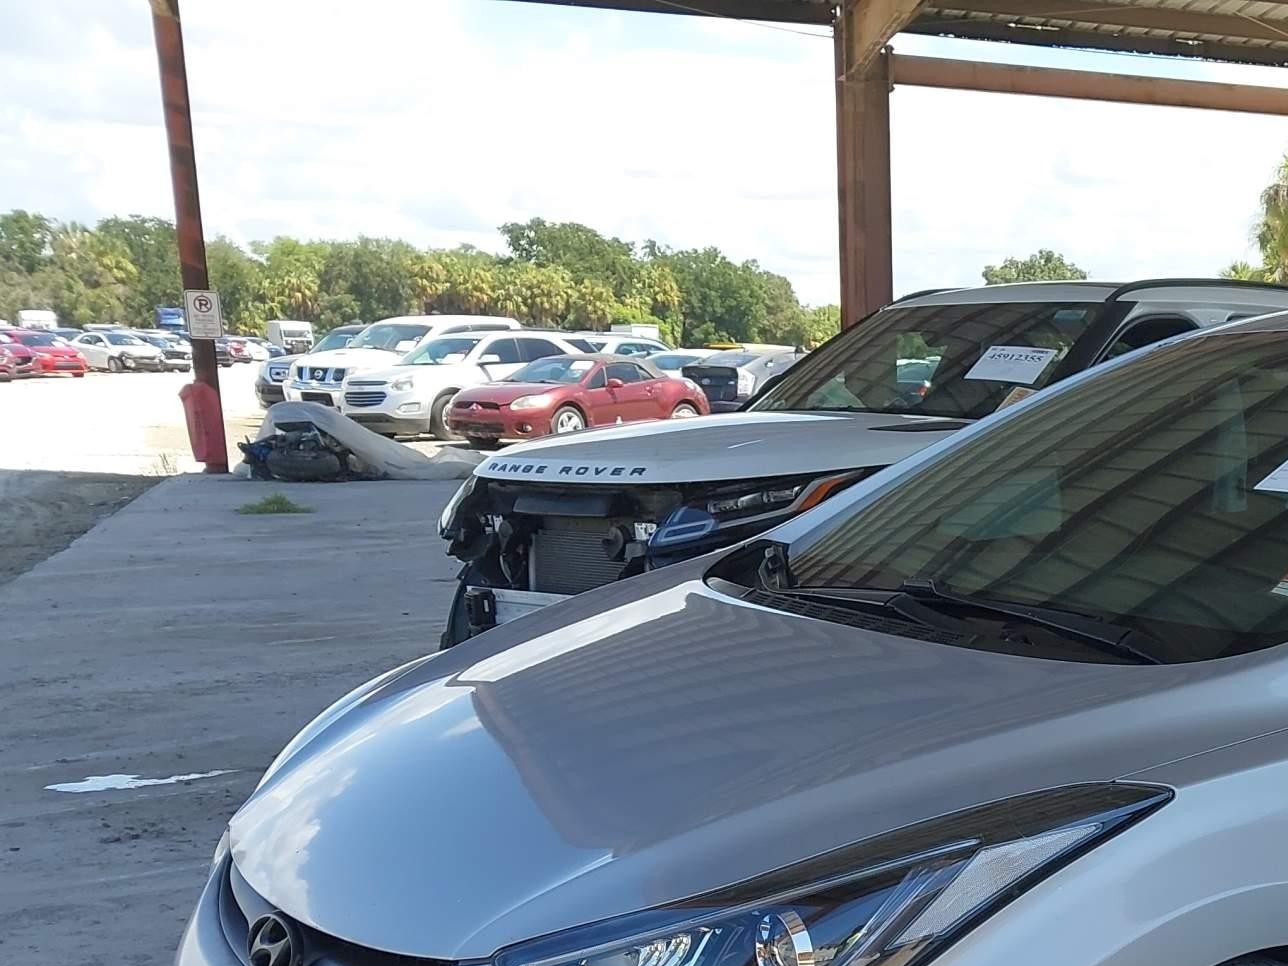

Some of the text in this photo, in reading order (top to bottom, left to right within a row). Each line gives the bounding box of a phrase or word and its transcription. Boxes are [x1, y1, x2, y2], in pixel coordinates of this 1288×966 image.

[987, 352, 1044, 363] 45912355
[488, 462, 648, 477] RANGE ROVER
